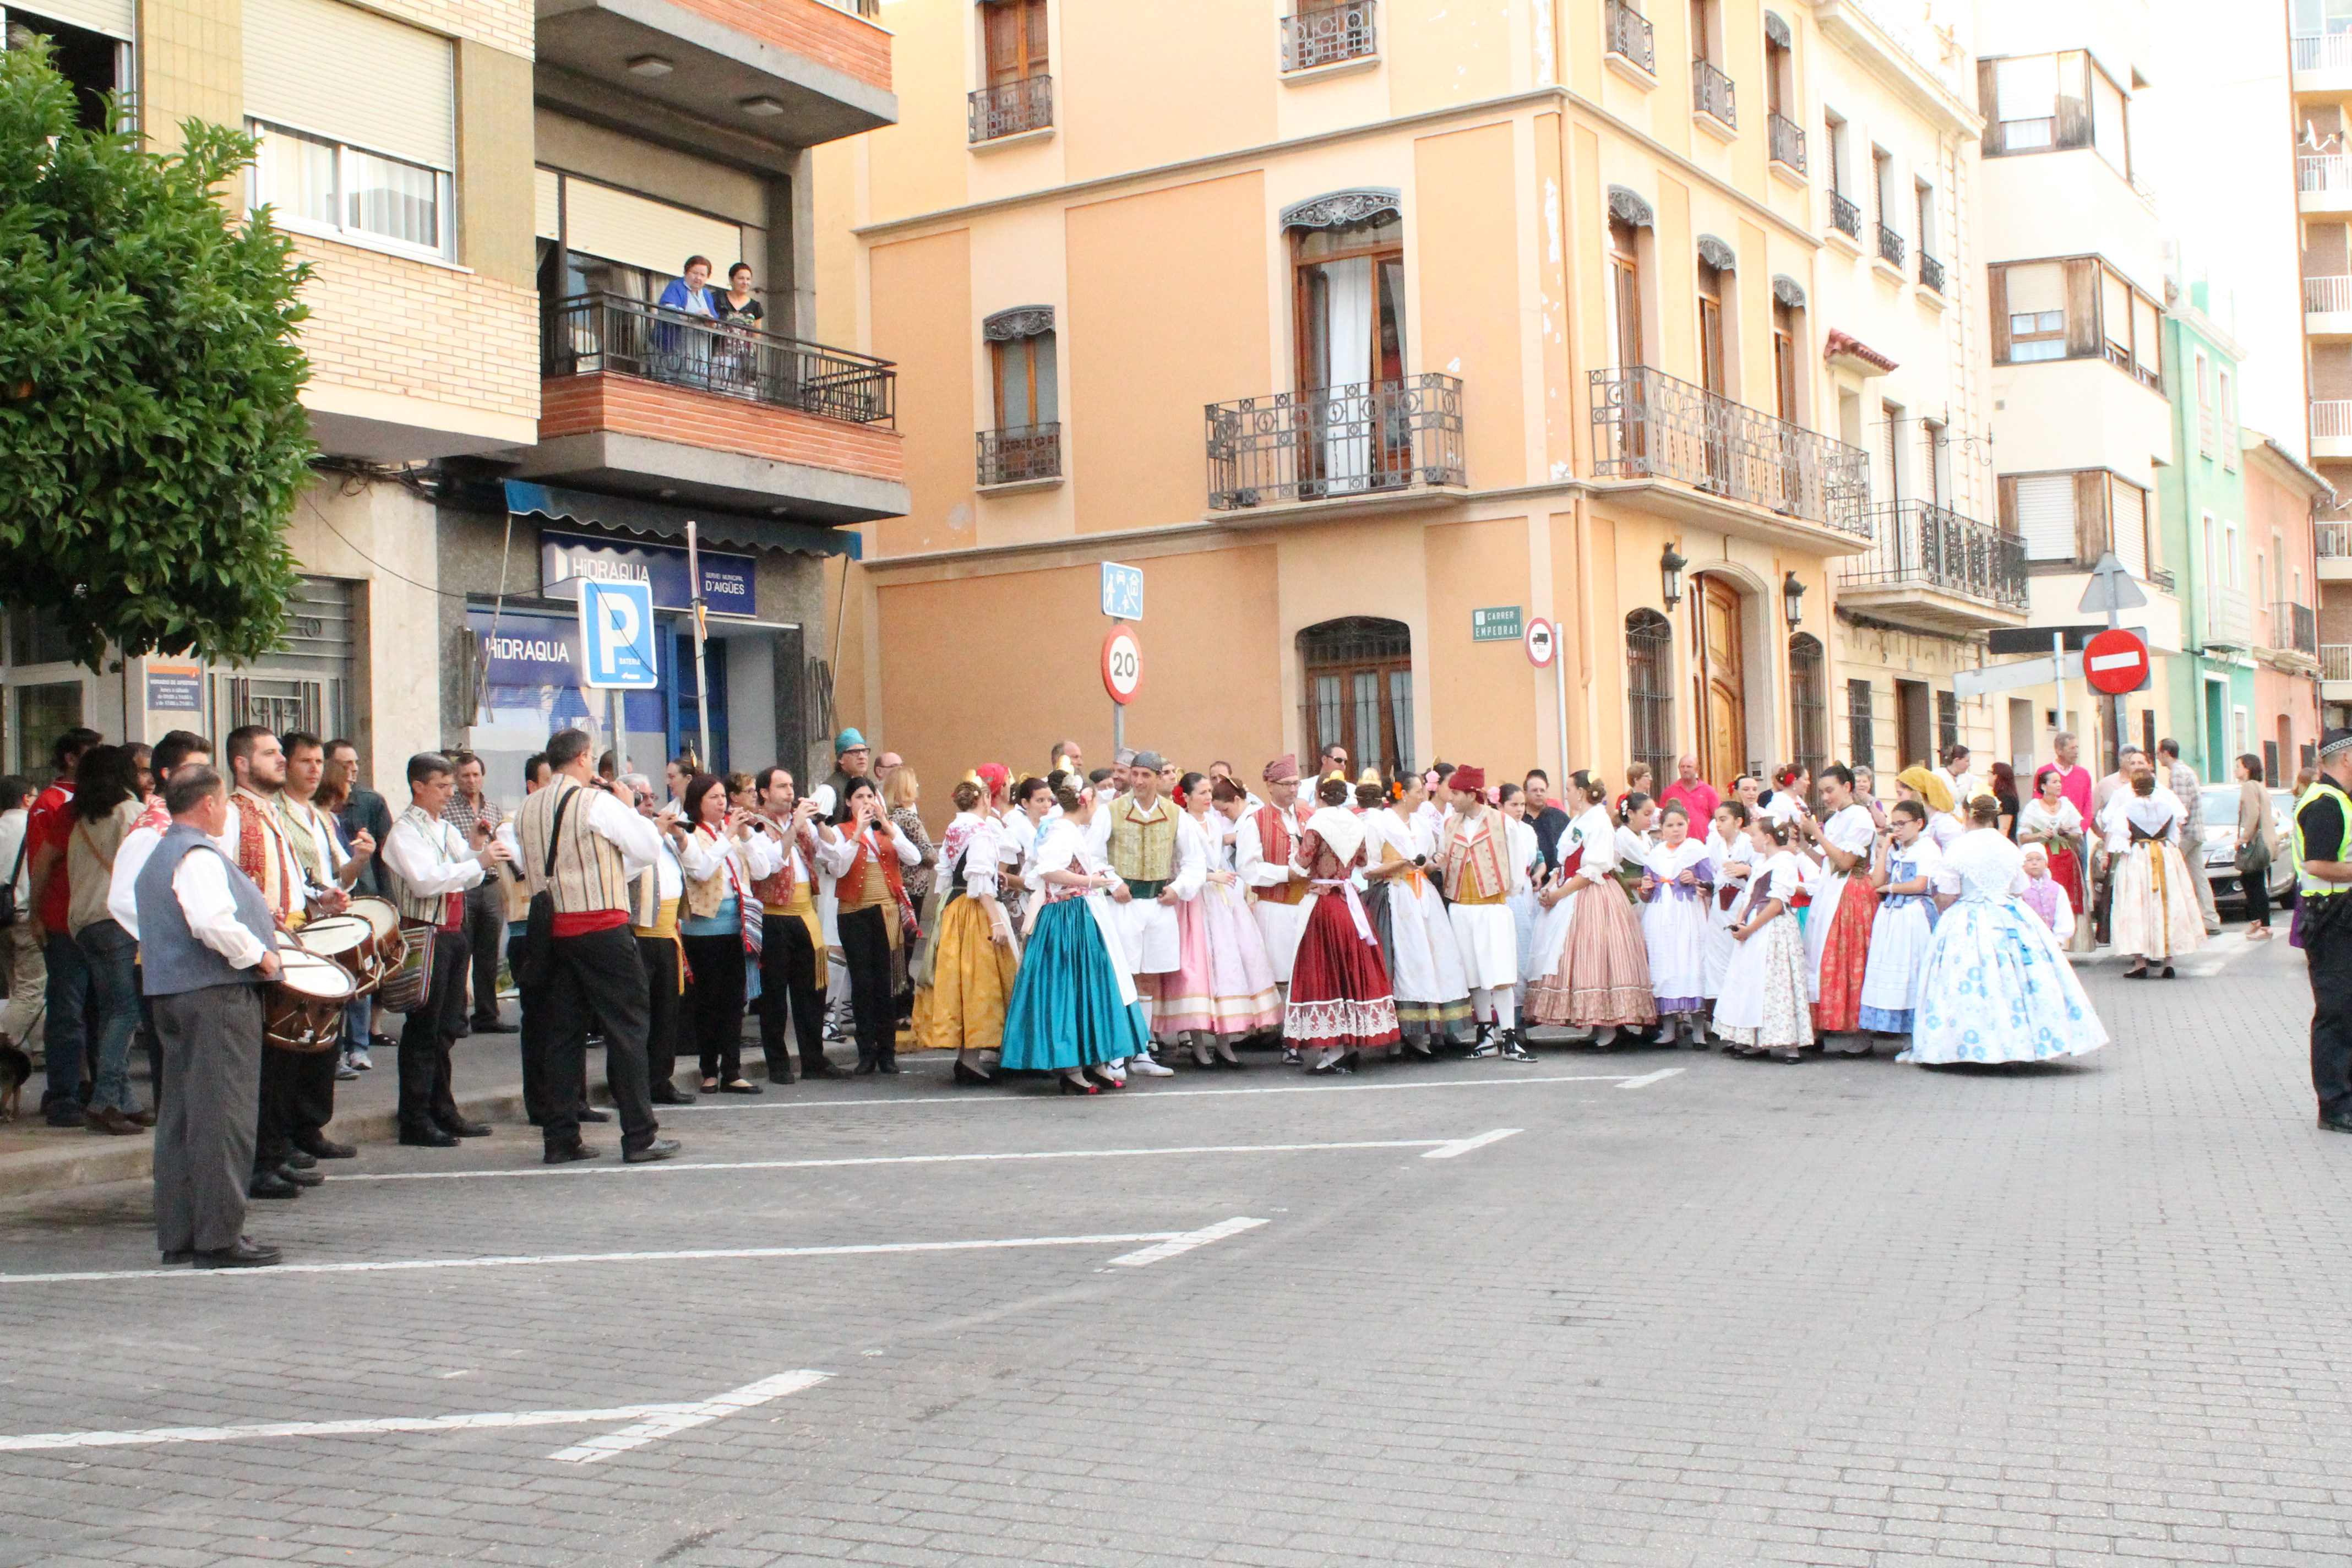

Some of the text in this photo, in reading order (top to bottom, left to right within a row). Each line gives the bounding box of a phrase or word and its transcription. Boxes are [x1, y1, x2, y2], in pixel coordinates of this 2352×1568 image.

[1487, 611, 1514, 620] CARRER
[597, 592, 640, 674] P
[1476, 624, 1518, 637] EMPEDRAT
[1113, 651, 1135, 678] 20
